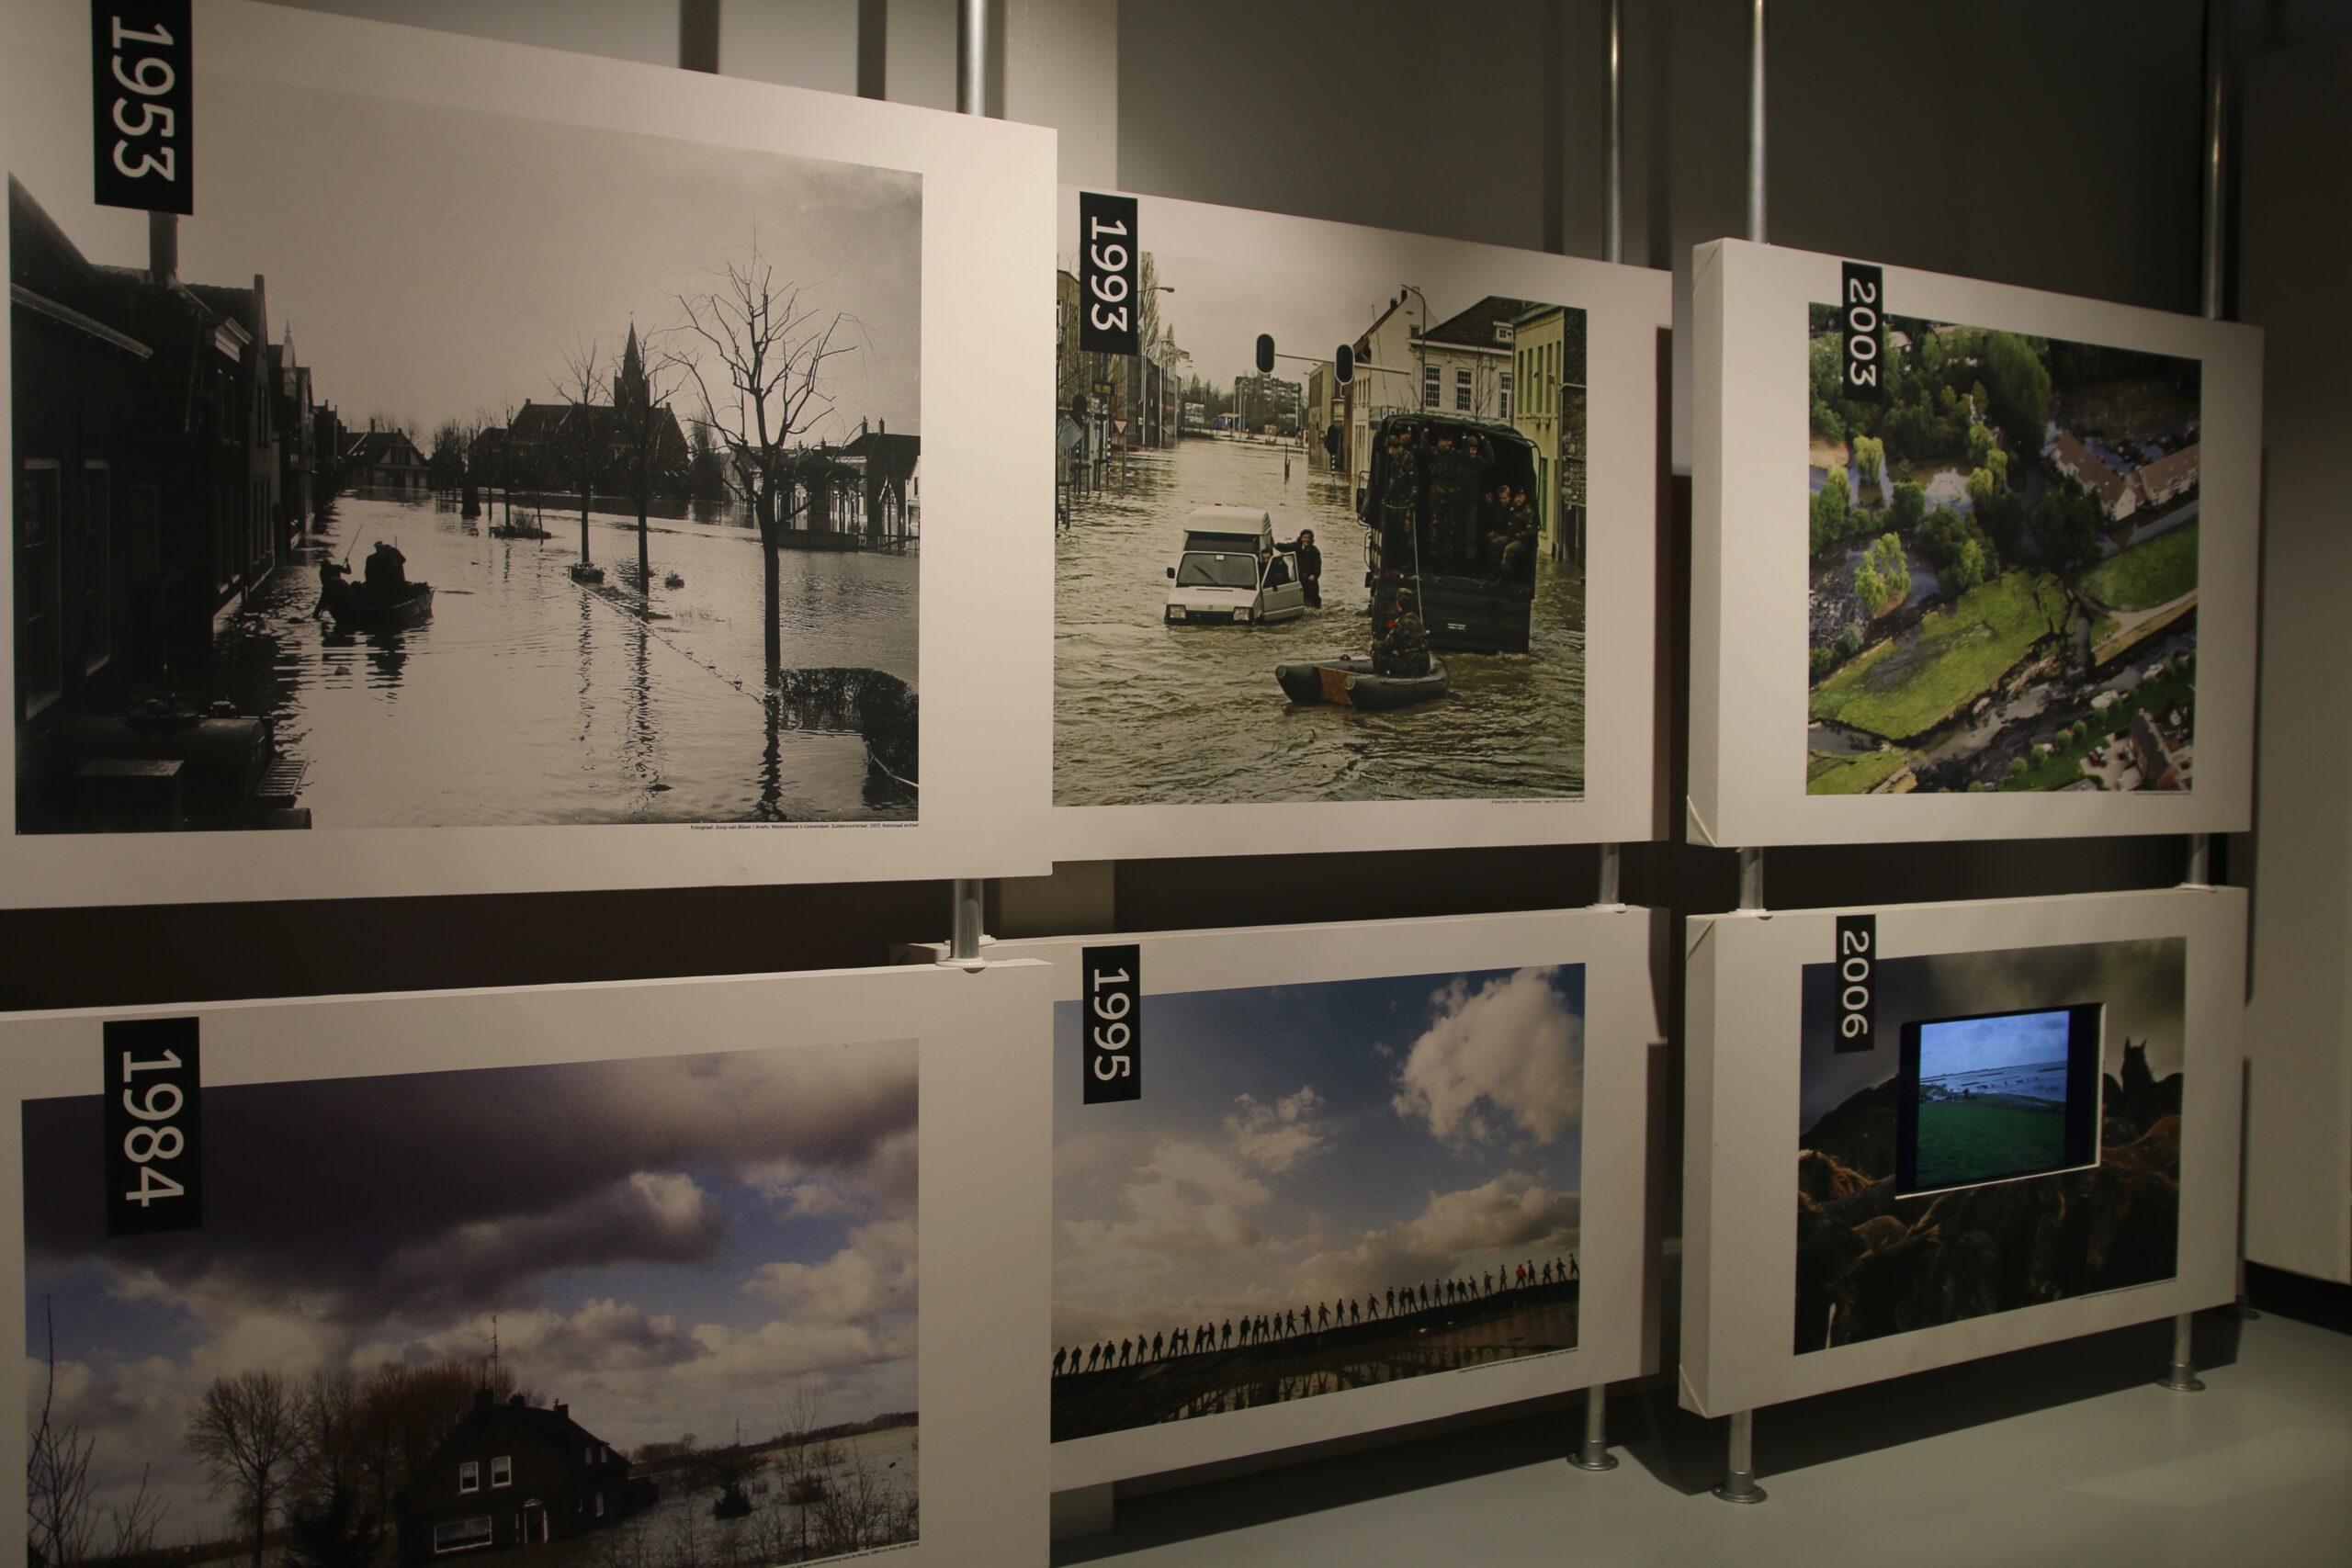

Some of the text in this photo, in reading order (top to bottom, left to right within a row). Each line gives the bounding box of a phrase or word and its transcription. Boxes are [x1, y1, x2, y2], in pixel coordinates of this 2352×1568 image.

[111, 16, 175, 182] 1953
[1091, 216, 1128, 333] 1993
[1849, 277, 1877, 387] 2003
[1093, 967, 1131, 1081] 1995
[1841, 930, 1870, 1038] 2006
[122, 1049, 185, 1207] 1984
